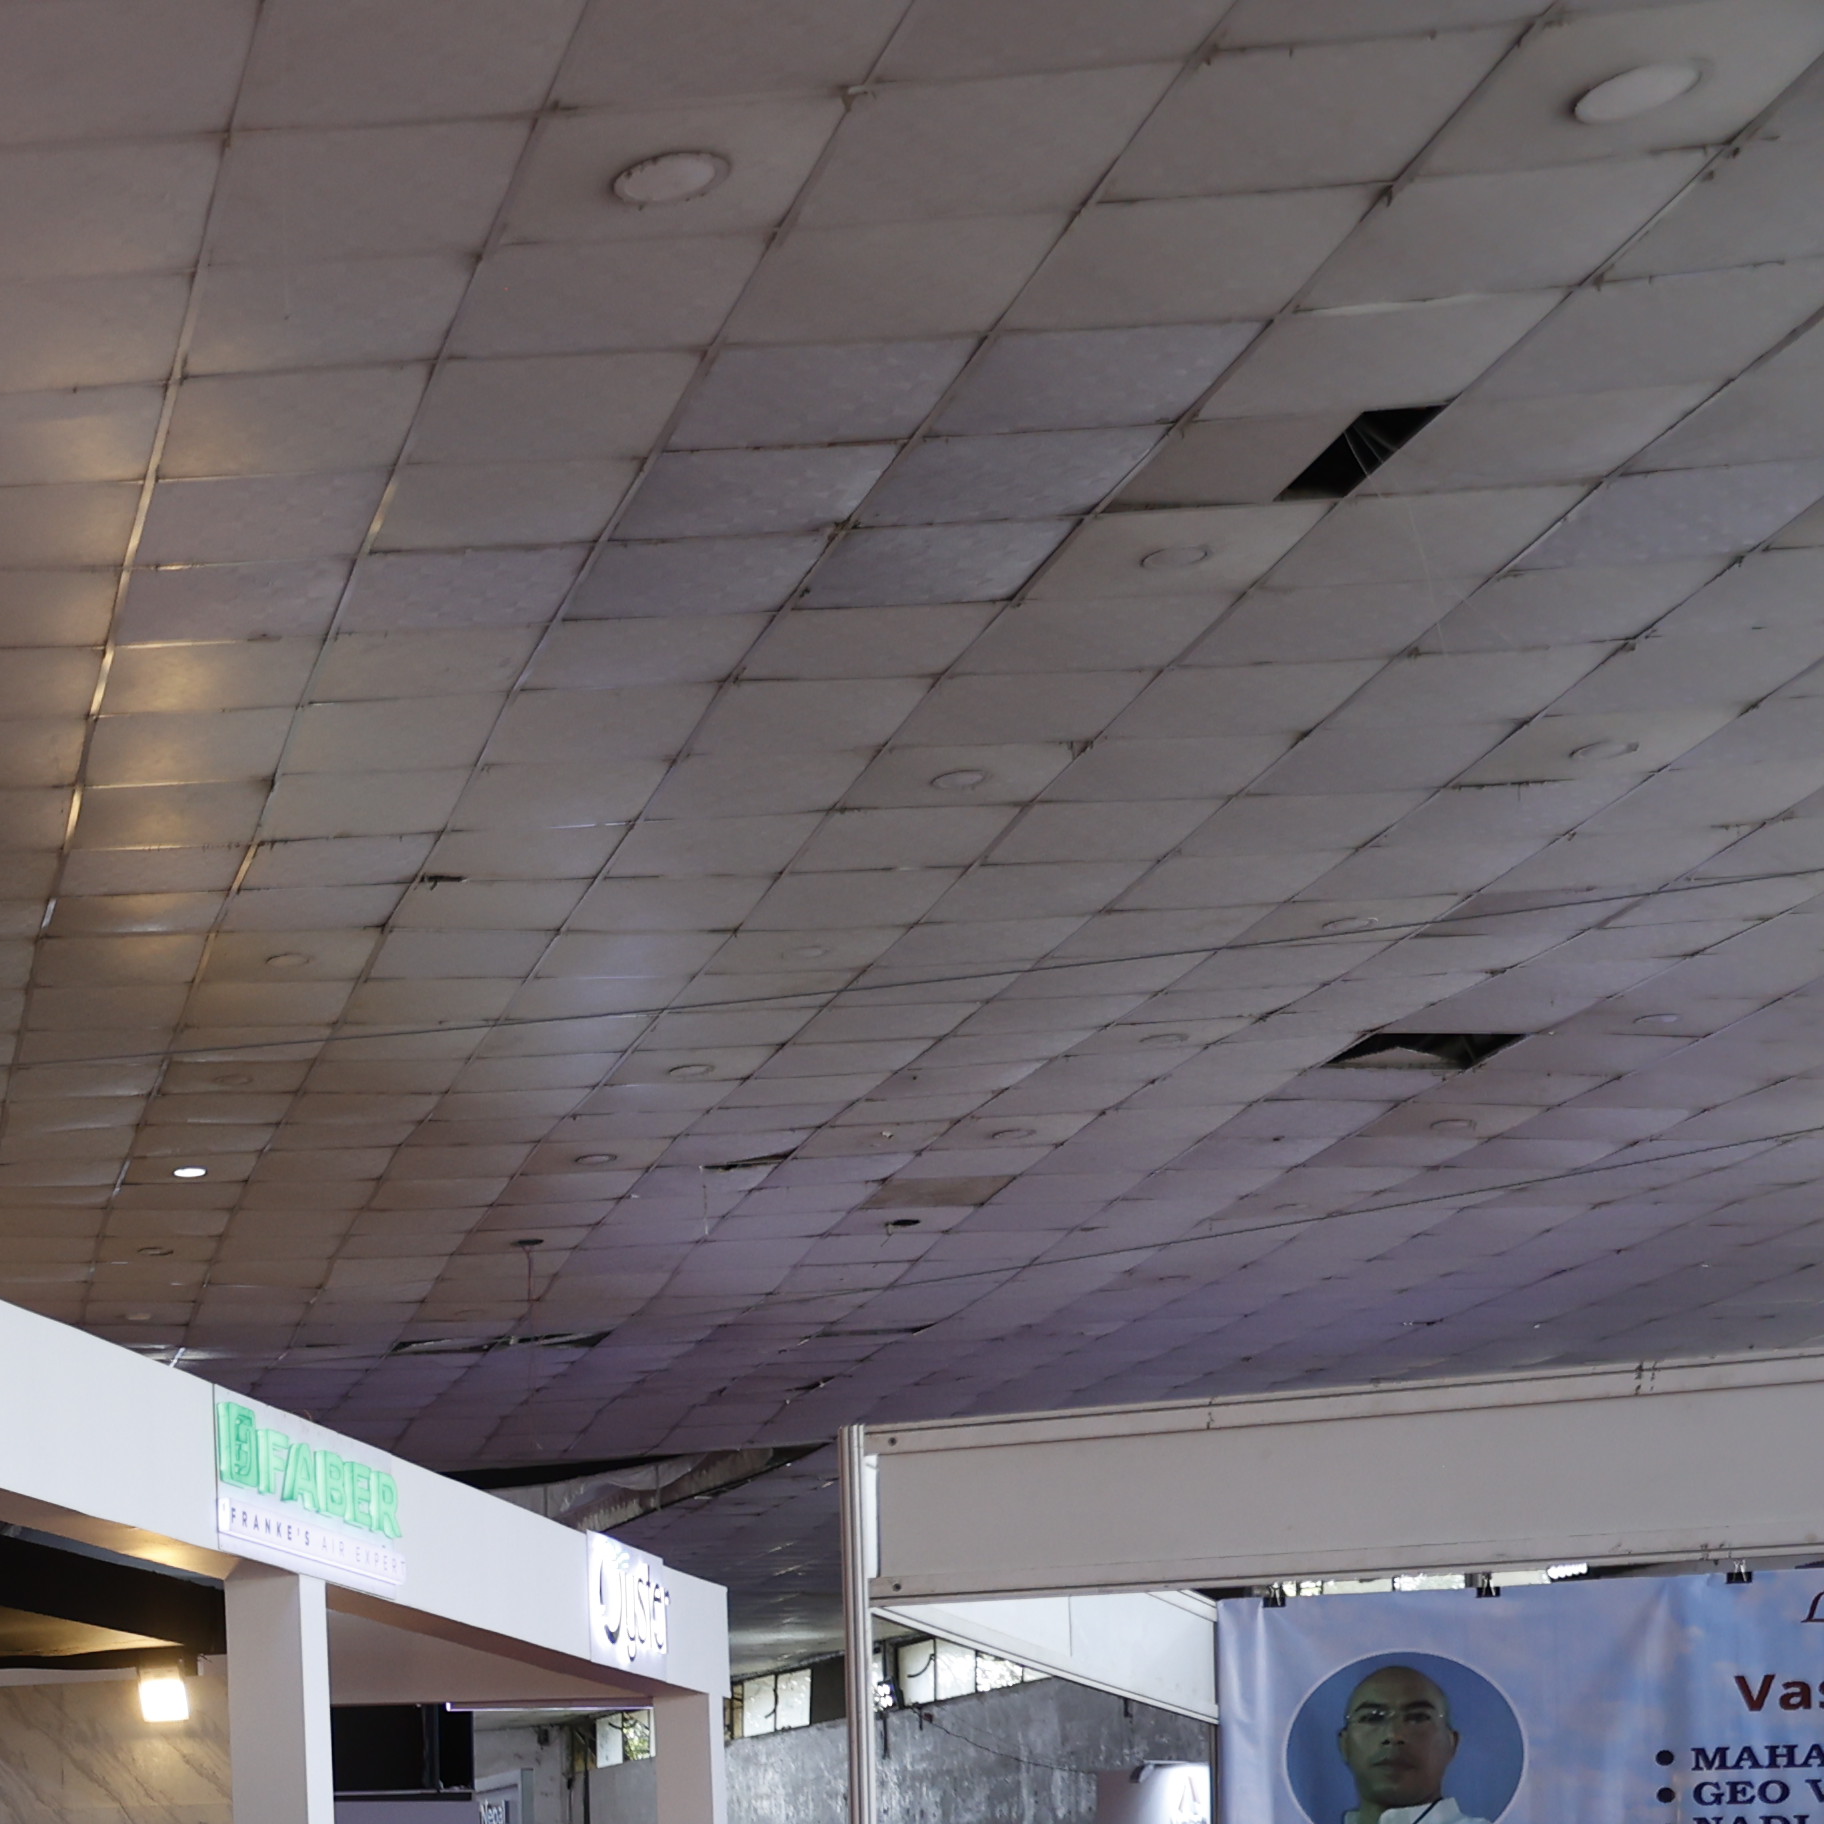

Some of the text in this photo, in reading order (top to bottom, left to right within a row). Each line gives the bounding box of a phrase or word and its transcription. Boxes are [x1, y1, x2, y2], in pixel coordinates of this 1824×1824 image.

[257, 1429, 402, 1539] FABER
[231, 1508, 310, 1546] FRANKE'S
[321, 1537, 345, 1557] AIR
[1693, 1780, 1790, 1805] GEO
